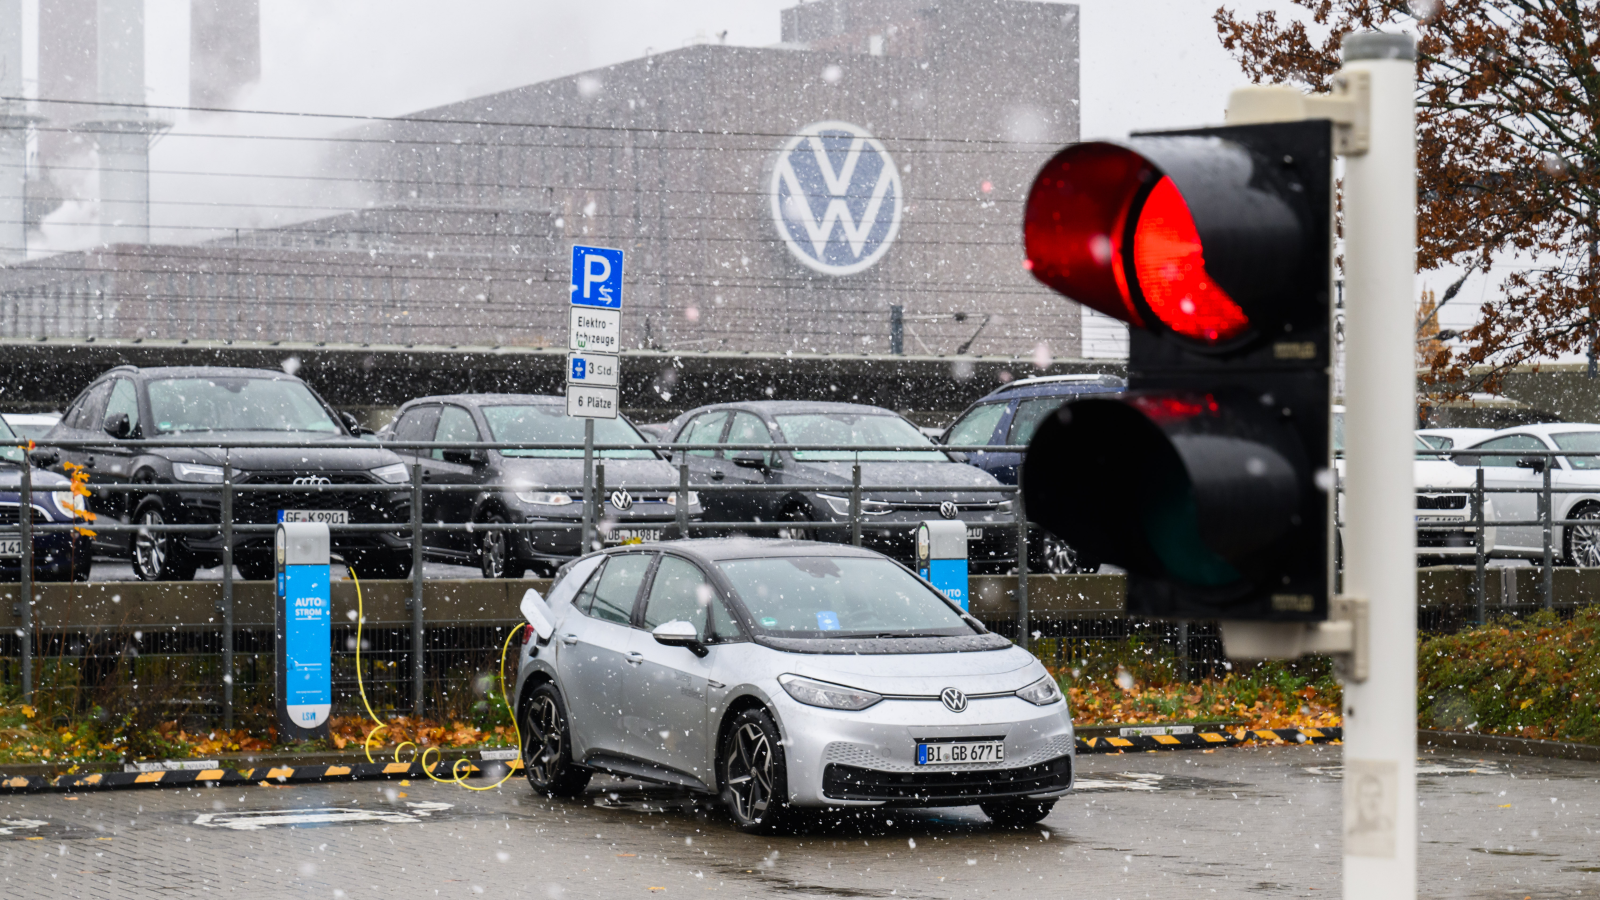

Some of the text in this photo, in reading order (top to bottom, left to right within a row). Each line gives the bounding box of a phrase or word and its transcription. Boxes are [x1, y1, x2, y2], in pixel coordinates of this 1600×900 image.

[583, 253, 611, 298] P
[588, 362, 614, 376] 3 Std.
[578, 395, 612, 409] 6 Plätze
[295, 597, 322, 607] AUTO
[295, 608, 322, 617] STROM
[302, 711, 316, 721] LSW
[927, 747, 942, 762] BI
[951, 745, 967, 761] GB
